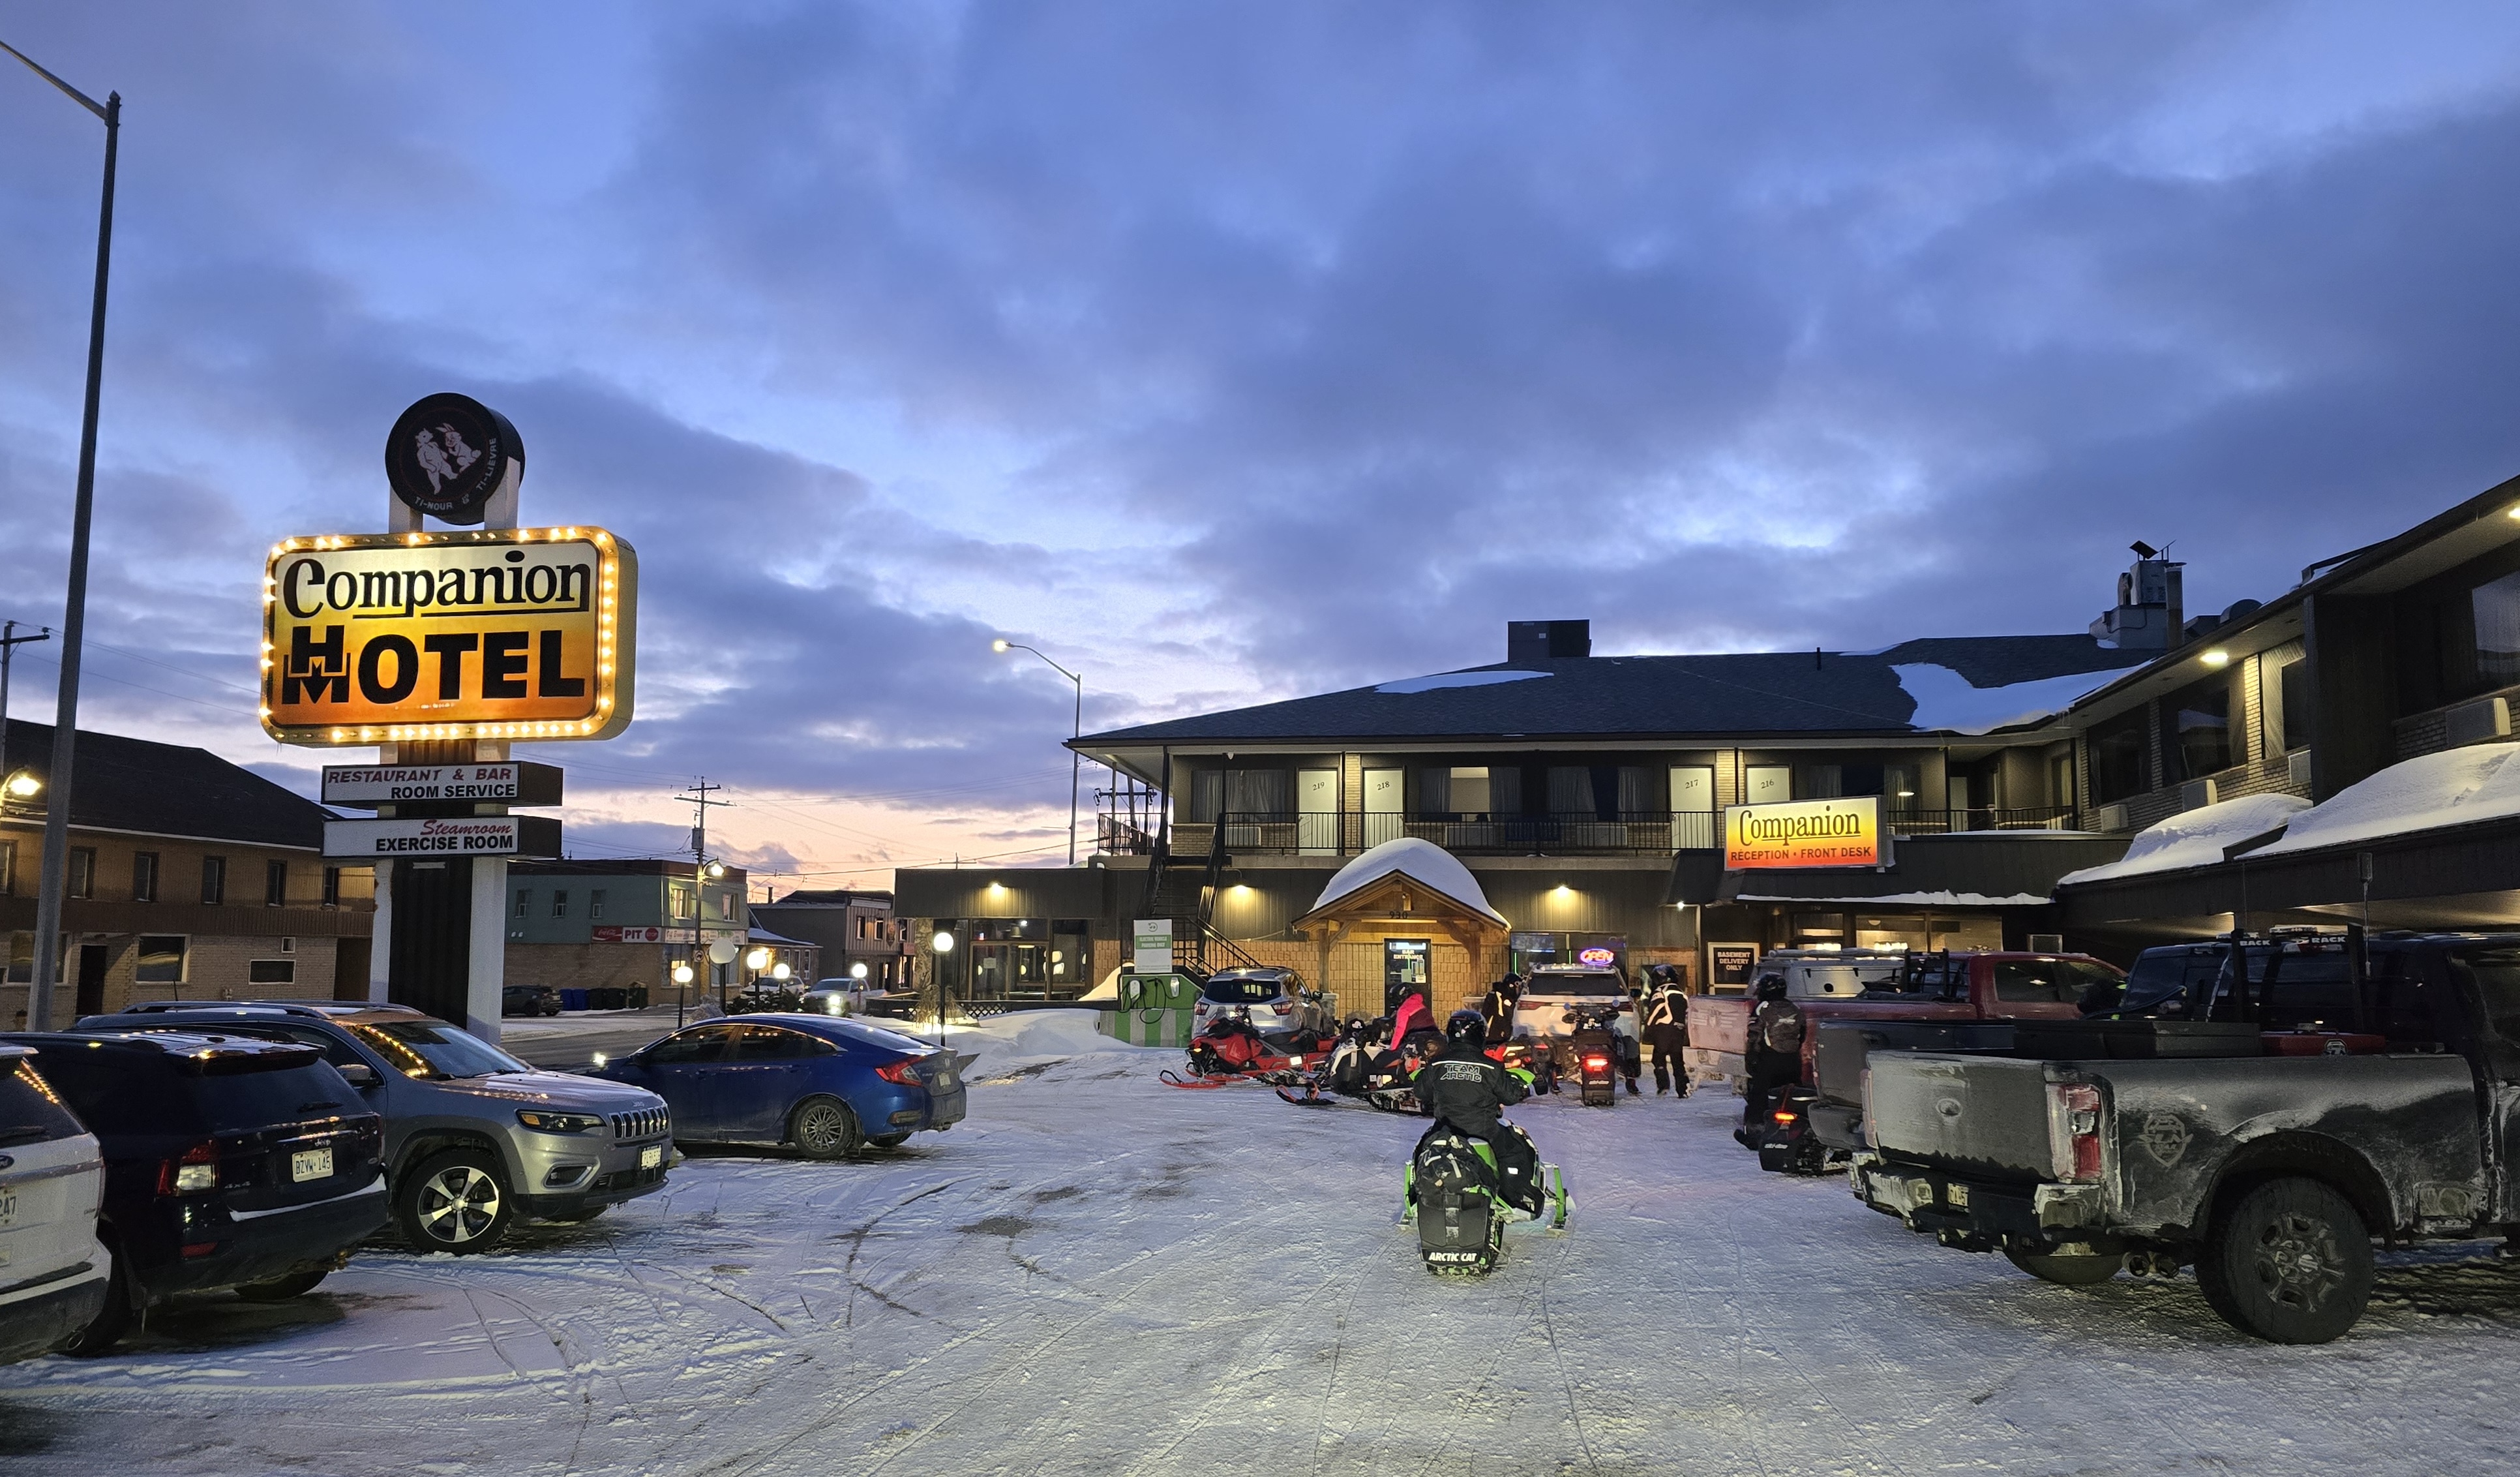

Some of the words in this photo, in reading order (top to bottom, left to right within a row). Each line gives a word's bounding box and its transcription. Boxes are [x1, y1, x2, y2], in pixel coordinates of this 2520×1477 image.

[415, 496, 453, 510] TI-NOUR
[283, 550, 591, 618] Companion
[327, 769, 442, 784] RESTAURANT
[453, 769, 464, 781] &
[475, 768, 511, 781] BAR
[1312, 782, 1325, 791] 219
[1377, 781, 1390, 791] 218
[1685, 779, 1699, 789] 217
[1761, 778, 1775, 789] 216
[391, 786, 439, 799] ROOM
[444, 784, 515, 797] SERVICE
[420, 819, 513, 836] Steamroom
[1739, 806, 1861, 846] Companion
[376, 836, 458, 852] EXERCISE
[463, 835, 513, 849] ROOM
[1730, 849, 1790, 861] RÉCEPTION
[1801, 847, 1837, 858] FRONT
[1840, 846, 1872, 857] DESK
[1389, 911, 1408, 919] 930
[624, 930, 642, 939] PIT
[1584, 951, 1614, 962] OPEN
[1444, 1064, 1480, 1074] TEAM
[1440, 1073, 1482, 1083] ARCTIC
[1428, 1252, 1460, 1262] ARCTIC
[1461, 1253, 1477, 1262] CAT
